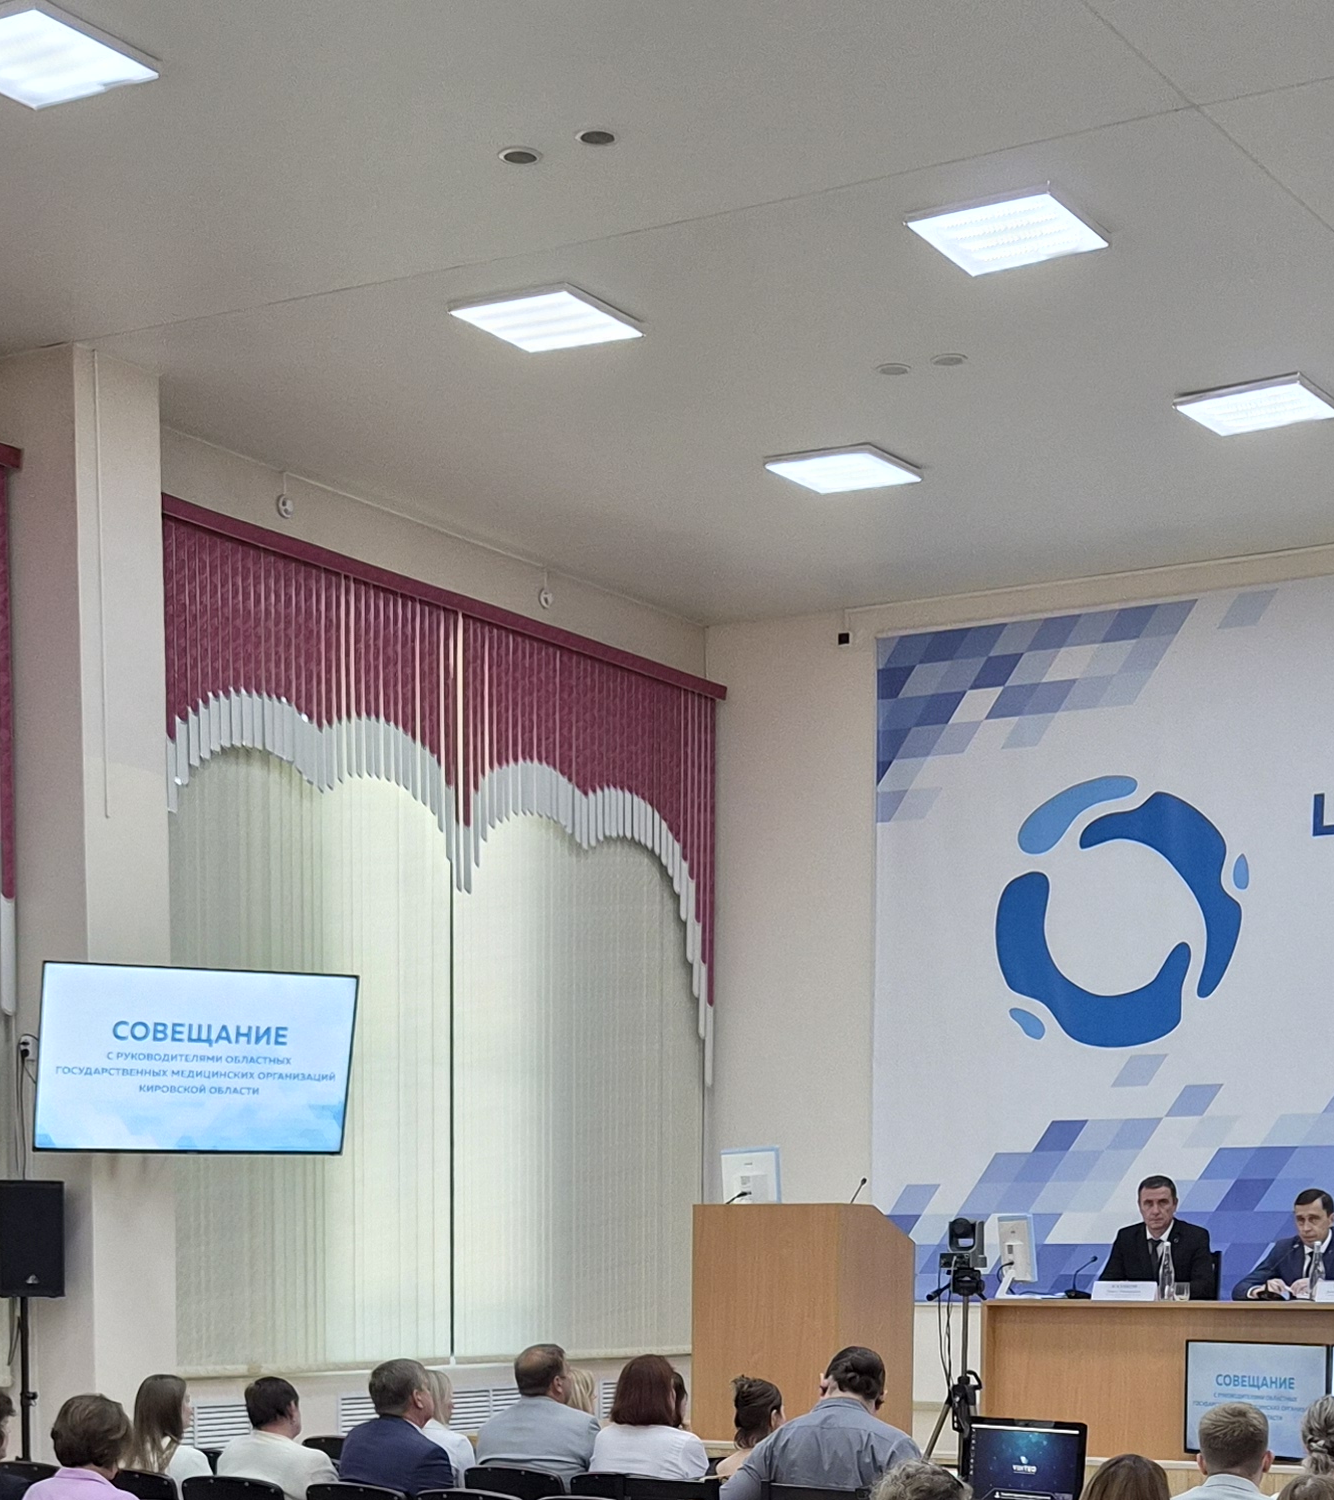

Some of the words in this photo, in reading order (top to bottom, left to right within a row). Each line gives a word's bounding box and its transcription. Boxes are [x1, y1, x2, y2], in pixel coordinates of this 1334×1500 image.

[112, 1020, 288, 1047] СОВЕЩАНИЕ
[116, 1052, 222, 1063] РУКОВОДИТЕЛЯМИ
[225, 1055, 292, 1065] ОБЛАСТНЫХ
[55, 1066, 168, 1077] ГОСУДАРСТВЕННЫХ
[171, 1069, 255, 1080] МЕДИЦИНСКИХ
[257, 1071, 336, 1082] ОРГАНИЗАЦИЙ
[139, 1083, 206, 1094] КИРОВСКОЙ
[209, 1086, 260, 1095] ОБЛАСТИ
[1215, 1374, 1295, 1390] СОВЕЩАНИЕ
